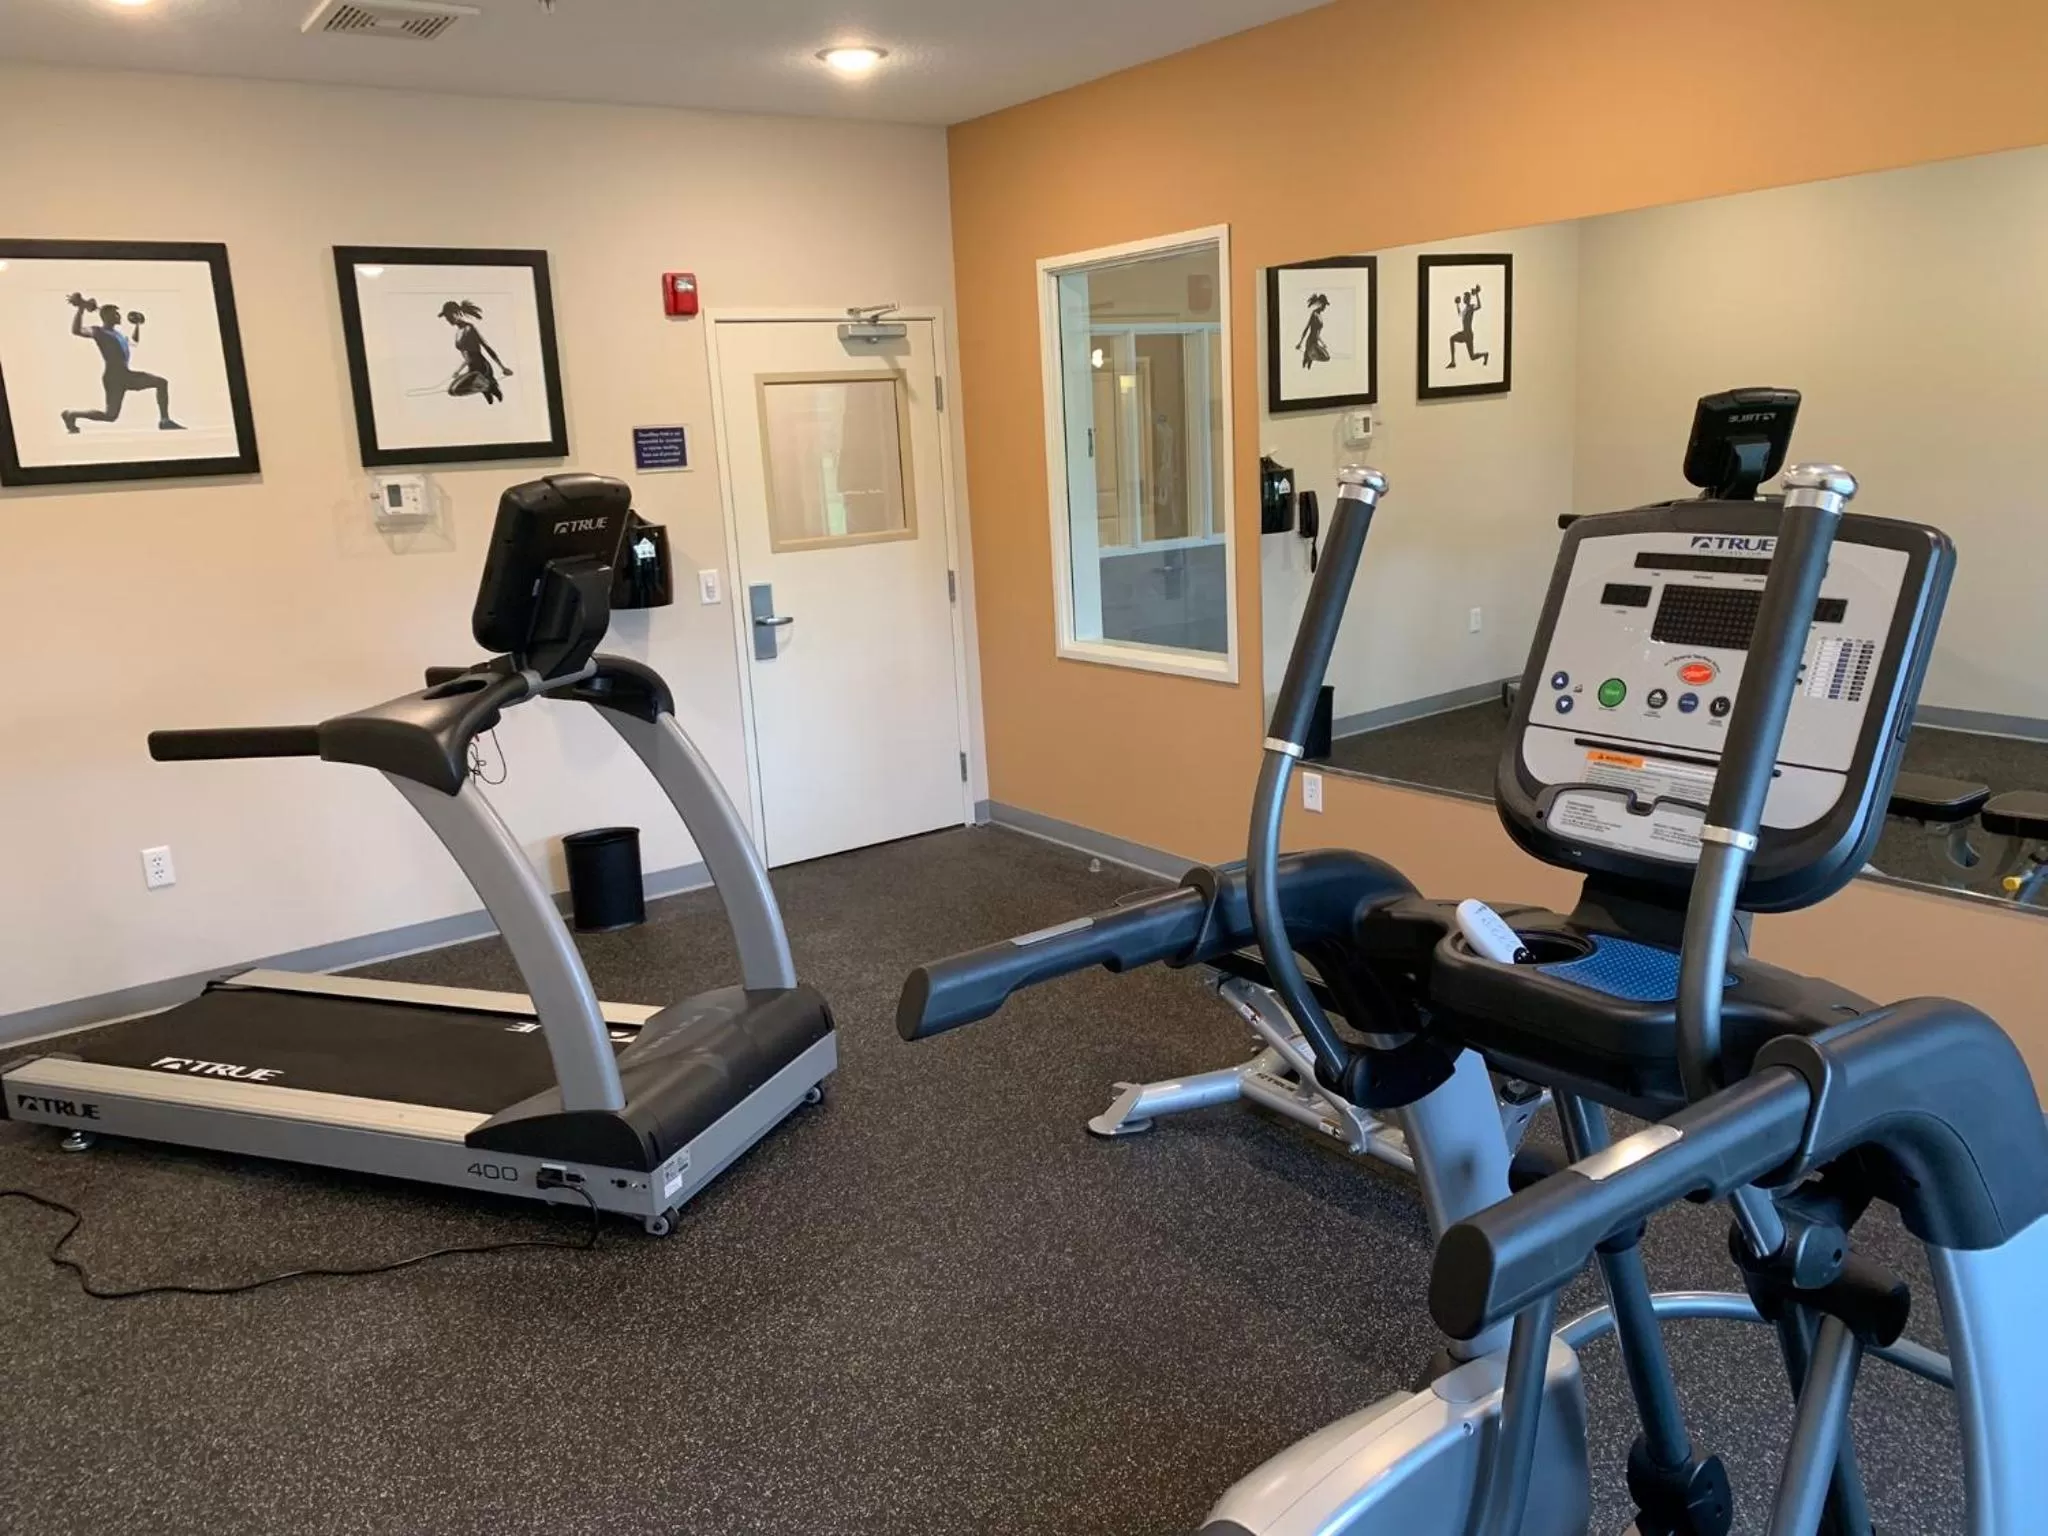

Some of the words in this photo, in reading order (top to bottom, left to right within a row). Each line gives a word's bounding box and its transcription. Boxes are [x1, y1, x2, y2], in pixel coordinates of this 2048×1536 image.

[570, 516, 609, 532] TRUE
[1715, 536, 1777, 552] TRUE
[188, 1060, 284, 1081] TRUE
[41, 1098, 100, 1120] TRUE
[467, 1163, 518, 1182] 400
